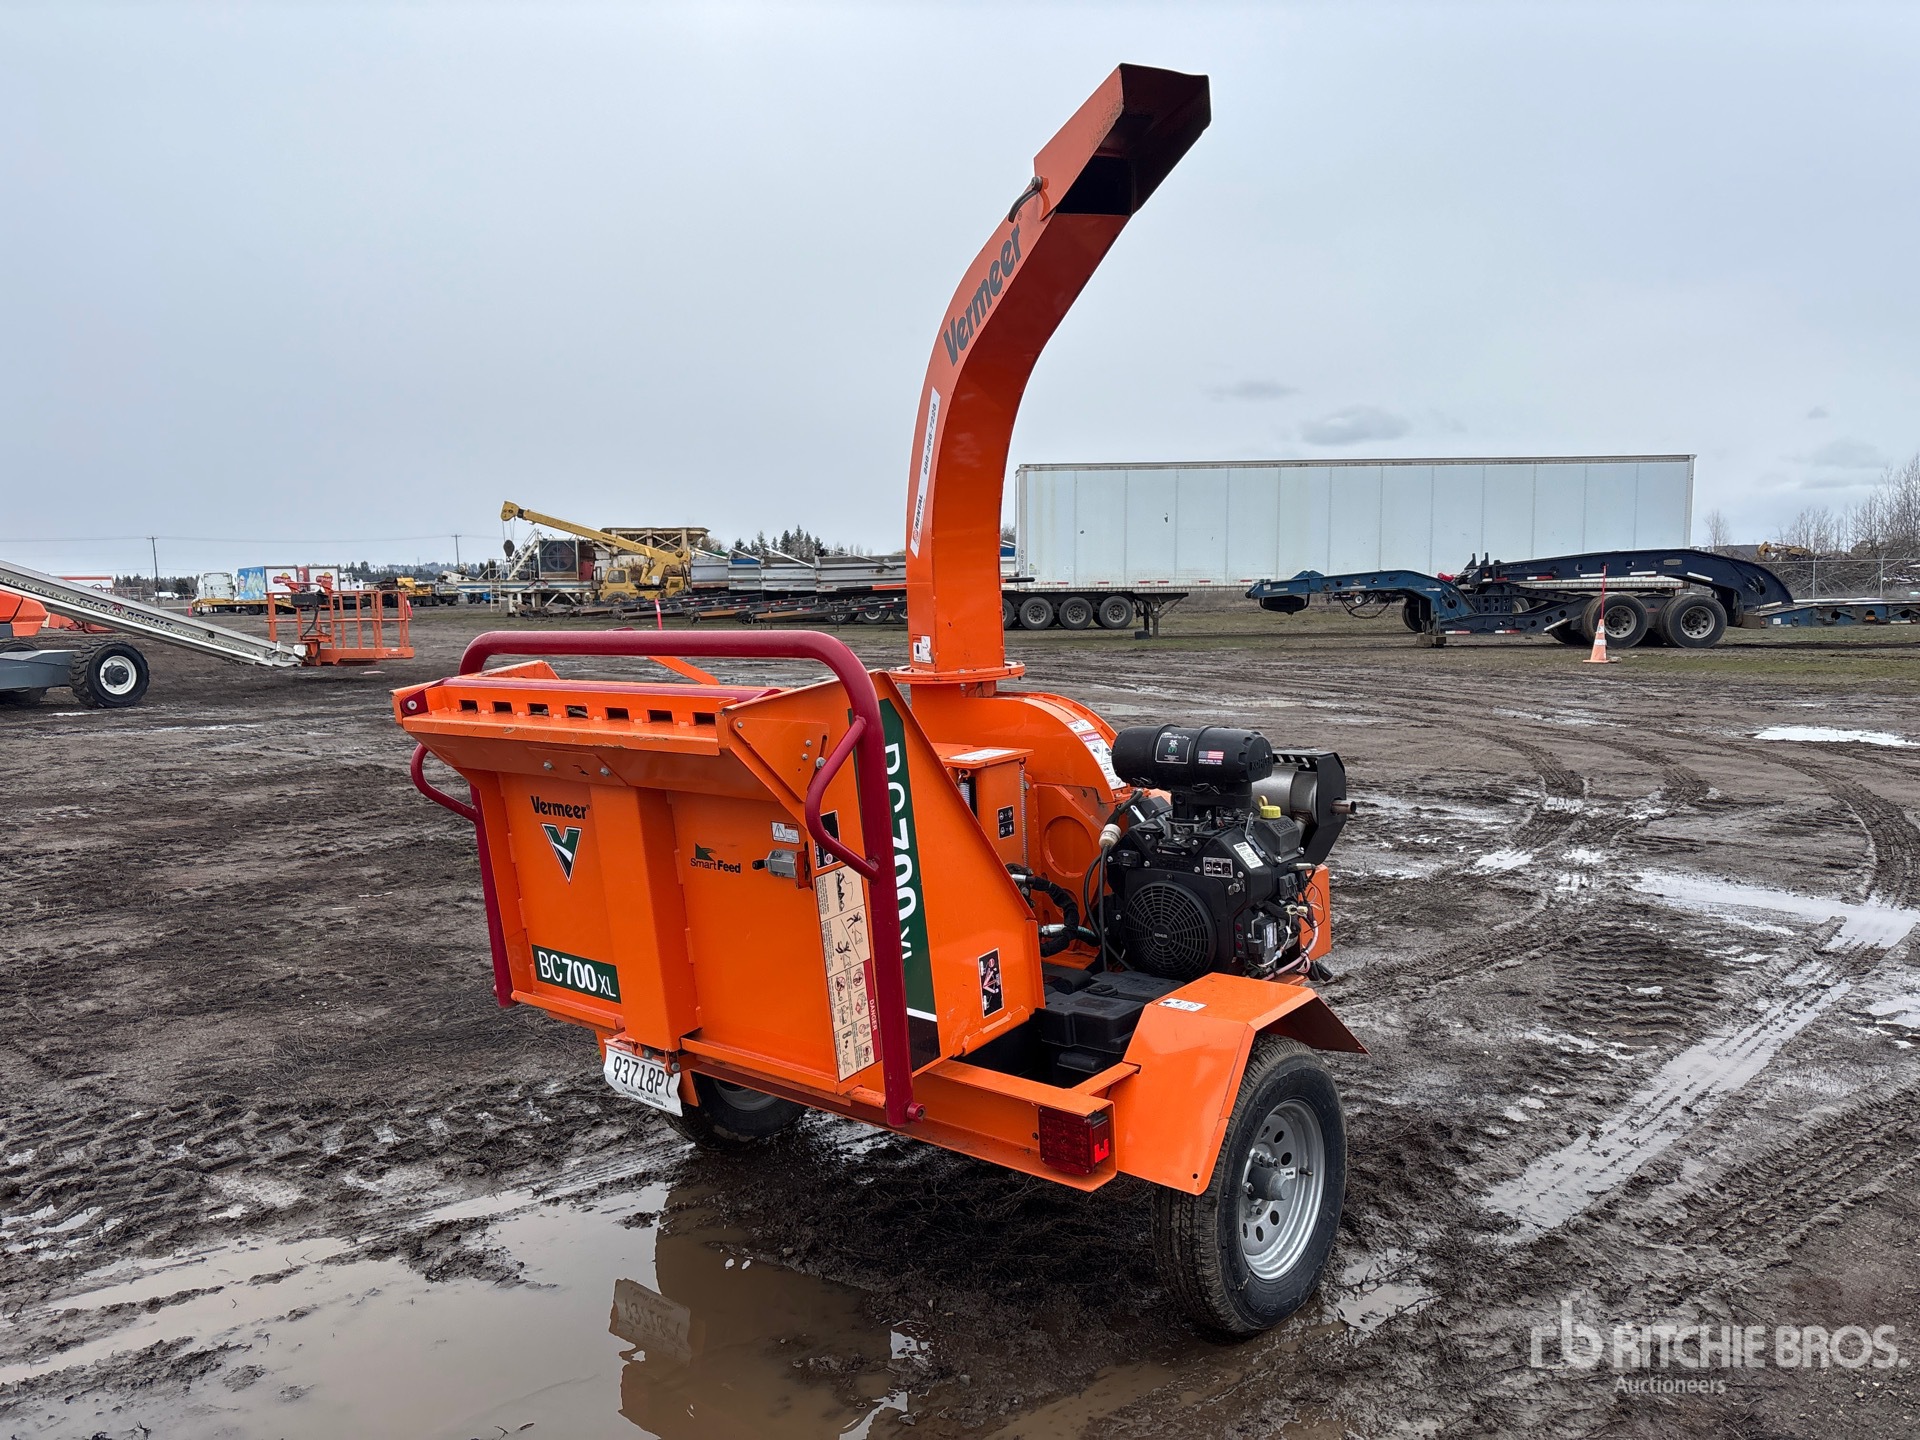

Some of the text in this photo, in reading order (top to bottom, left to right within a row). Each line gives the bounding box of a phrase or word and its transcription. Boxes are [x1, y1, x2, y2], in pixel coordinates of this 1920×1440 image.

[943, 223, 1022, 367] Vermeer
[530, 795, 587, 820] Vermeer
[869, 999, 878, 1032] DANGER
